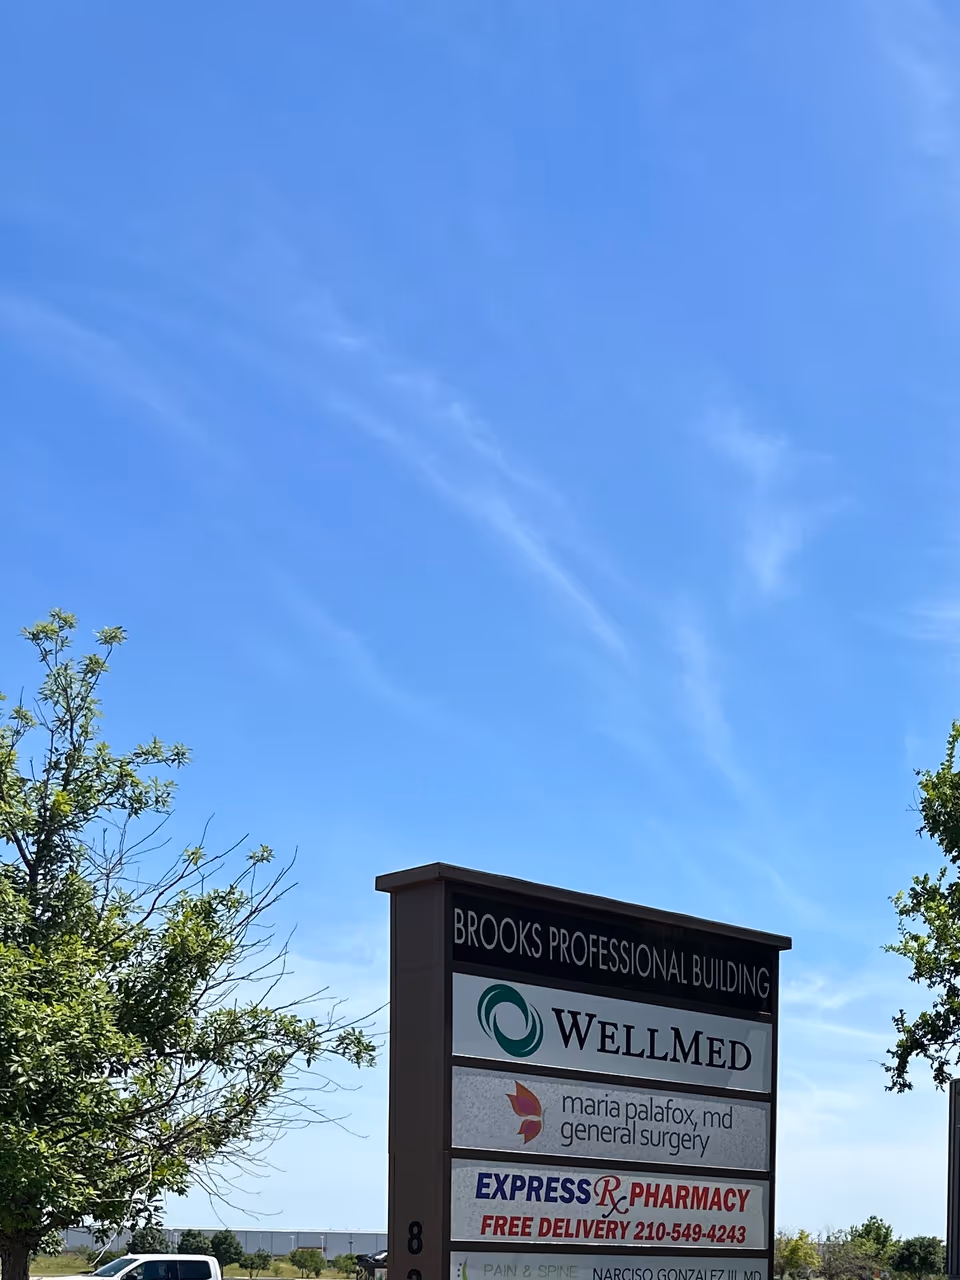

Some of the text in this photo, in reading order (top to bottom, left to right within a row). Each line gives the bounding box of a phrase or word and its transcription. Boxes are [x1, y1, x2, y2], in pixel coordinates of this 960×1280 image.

[454, 907, 770, 998] BROOKS PROFESSIONAL BUILDING
[562, 1094, 733, 1132] maria palafox, md
[561, 1120, 710, 1158] general surgery
[475, 1172, 592, 1205] EXPRESS
[629, 1182, 751, 1212] PHARMACY
[480, 1215, 746, 1244] FREE DELIVERY 210-549-4243
[483, 1264, 577, 1278] PAIN & SPINE
